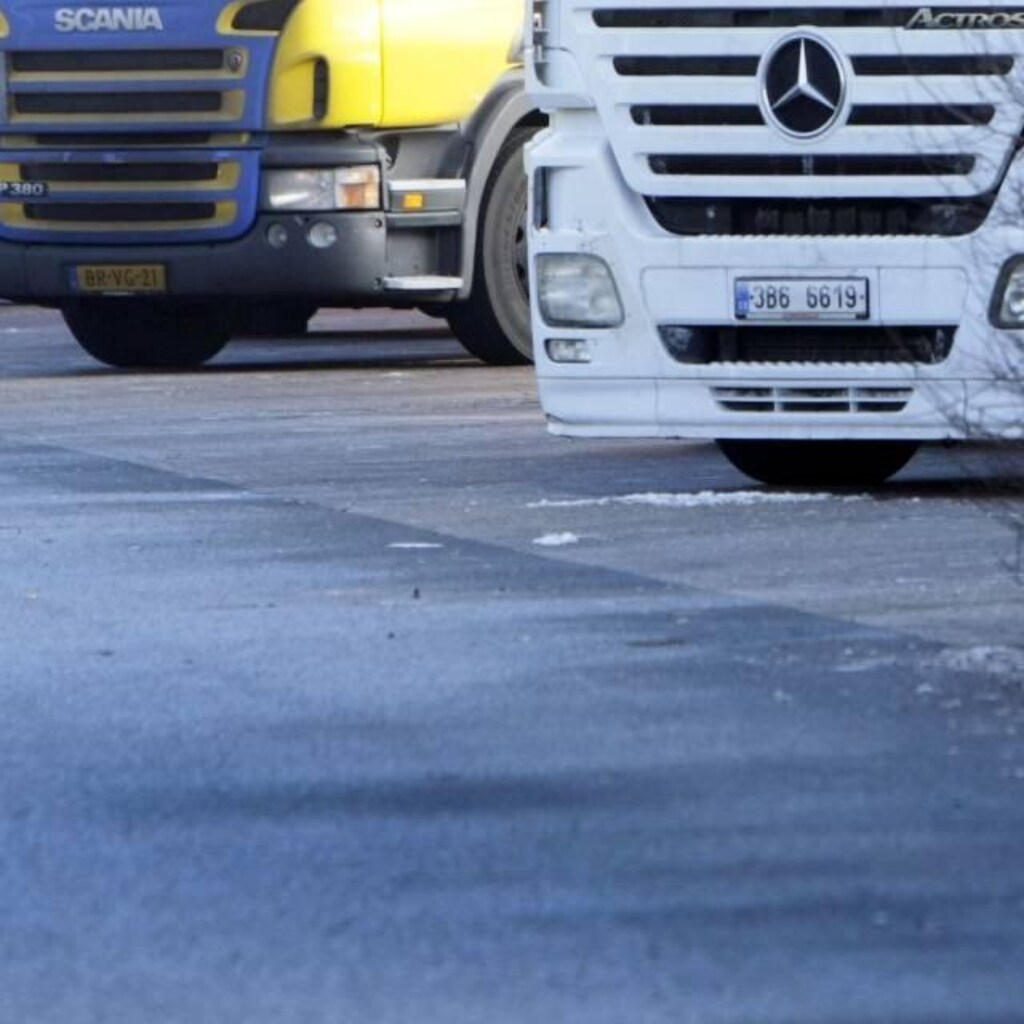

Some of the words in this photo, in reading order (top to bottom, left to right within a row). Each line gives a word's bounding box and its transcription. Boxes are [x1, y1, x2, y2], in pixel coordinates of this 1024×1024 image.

[54, 7, 164, 32] SCANIA
[10, 183, 44, 196] 380
[84, 268, 158, 287] BR-VG-21
[753, 285, 790, 309] 3B6
